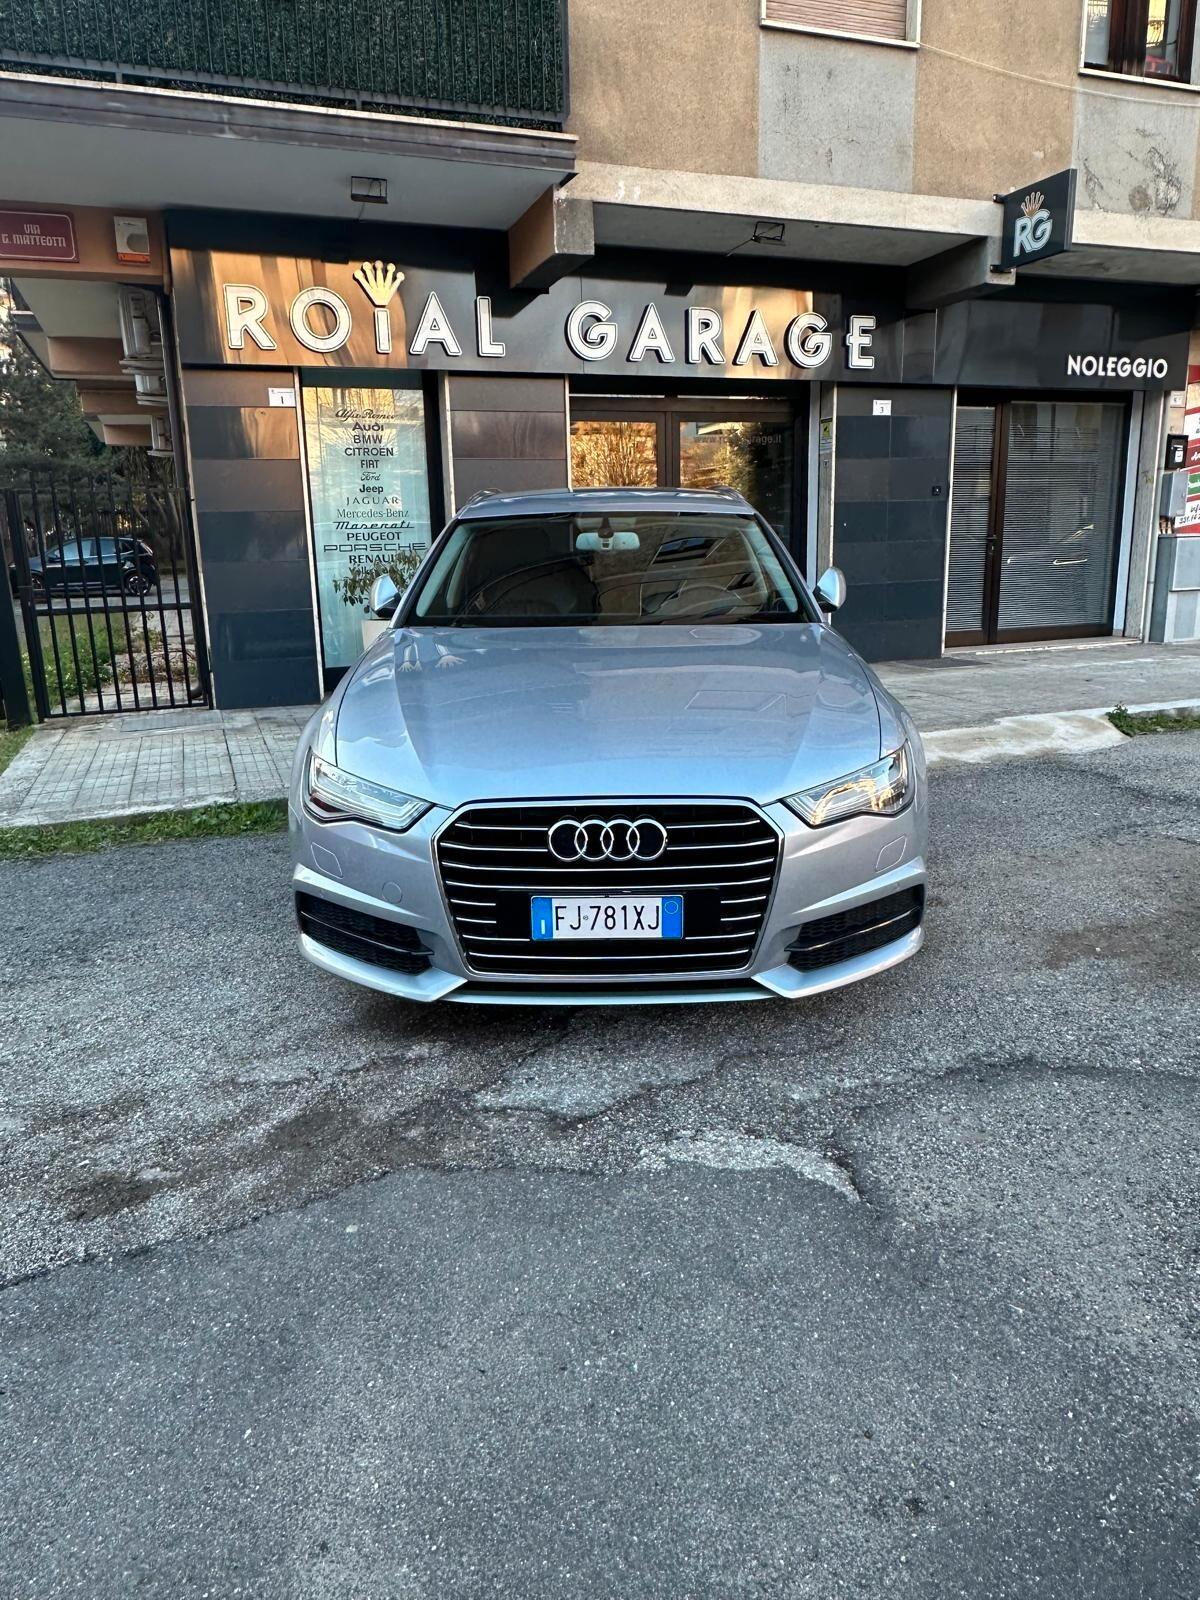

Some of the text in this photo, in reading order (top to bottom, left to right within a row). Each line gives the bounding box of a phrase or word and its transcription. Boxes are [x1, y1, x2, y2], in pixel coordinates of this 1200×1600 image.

[23, 223, 41, 235] VIA
[1013, 208, 1053, 258] RG
[13, 234, 67, 248] MATTEOTTI
[567, 300, 877, 370] GARAGE
[1067, 354, 1168, 379] NOLEGGIO
[335, 408, 398, 422] Alfa Romeo
[352, 422, 384, 432] Audi
[353, 434, 383, 444] BMW
[344, 445, 394, 457] CITROËN
[360, 460, 380, 469] FIAT
[360, 471, 381, 481] Ford
[359, 484, 384, 494] Jeep
[346, 496, 400, 506] JAGUAR
[337, 508, 409, 519] Mercedes-Benz
[333, 520, 415, 530] Maserati
[347, 531, 402, 541] PEUGEOT
[323, 542, 428, 553] PORSCHE
